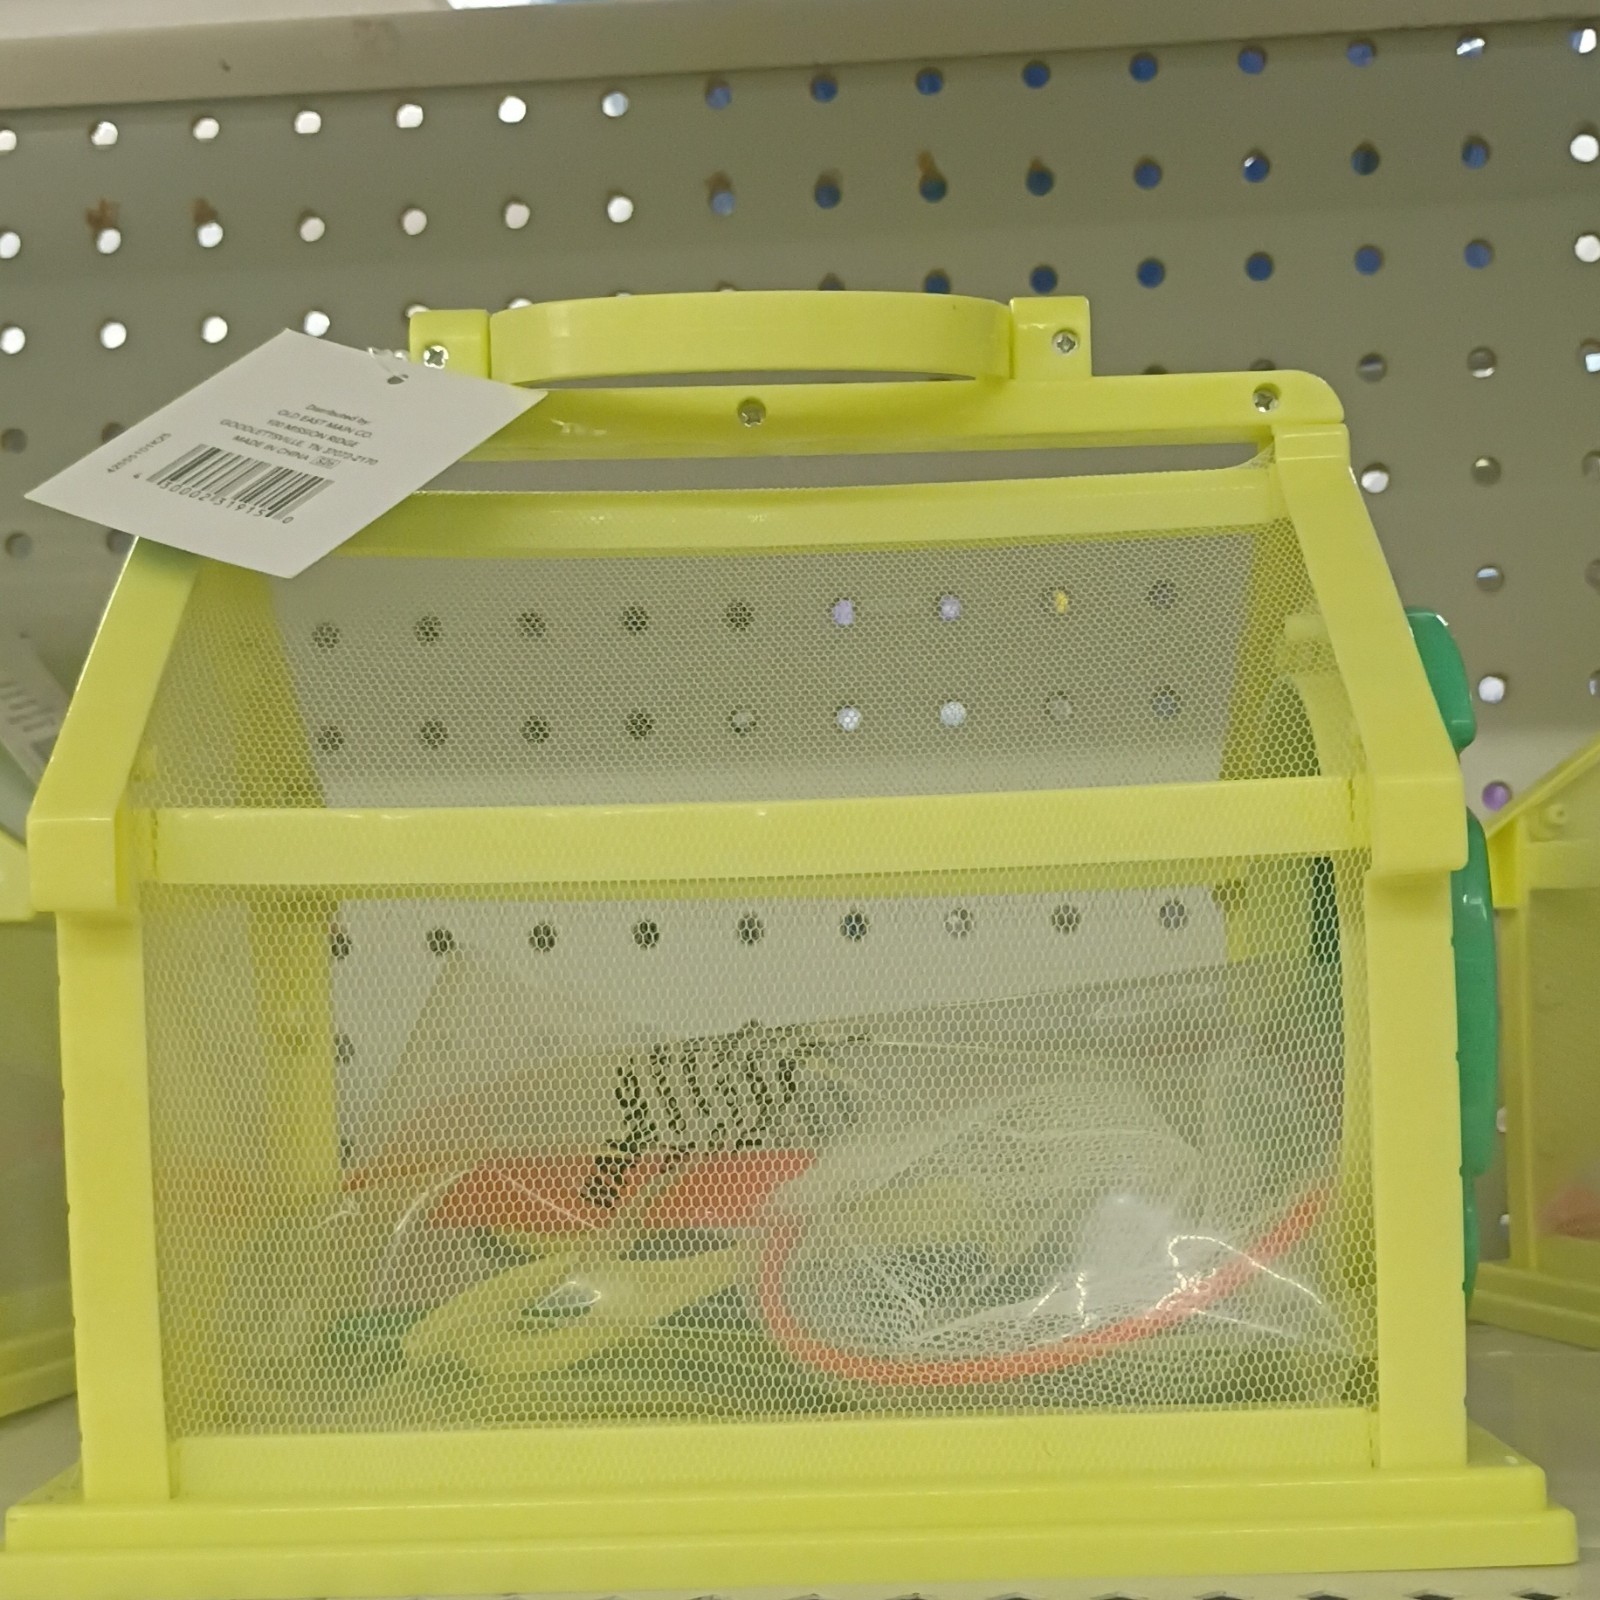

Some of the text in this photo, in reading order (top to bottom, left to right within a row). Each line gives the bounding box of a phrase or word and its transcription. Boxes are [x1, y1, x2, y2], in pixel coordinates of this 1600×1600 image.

[277, 409, 300, 419] OLD
[299, 415, 328, 425] EAST
[325, 422, 355, 433] MAIN
[305, 404, 357, 421] Distributed
[284, 424, 328, 439] MISSION
[326, 435, 360, 447] RIDGE
[308, 442, 322, 452] TN
[232, 435, 265, 448] MADE
[276, 448, 309, 460] CHINA
